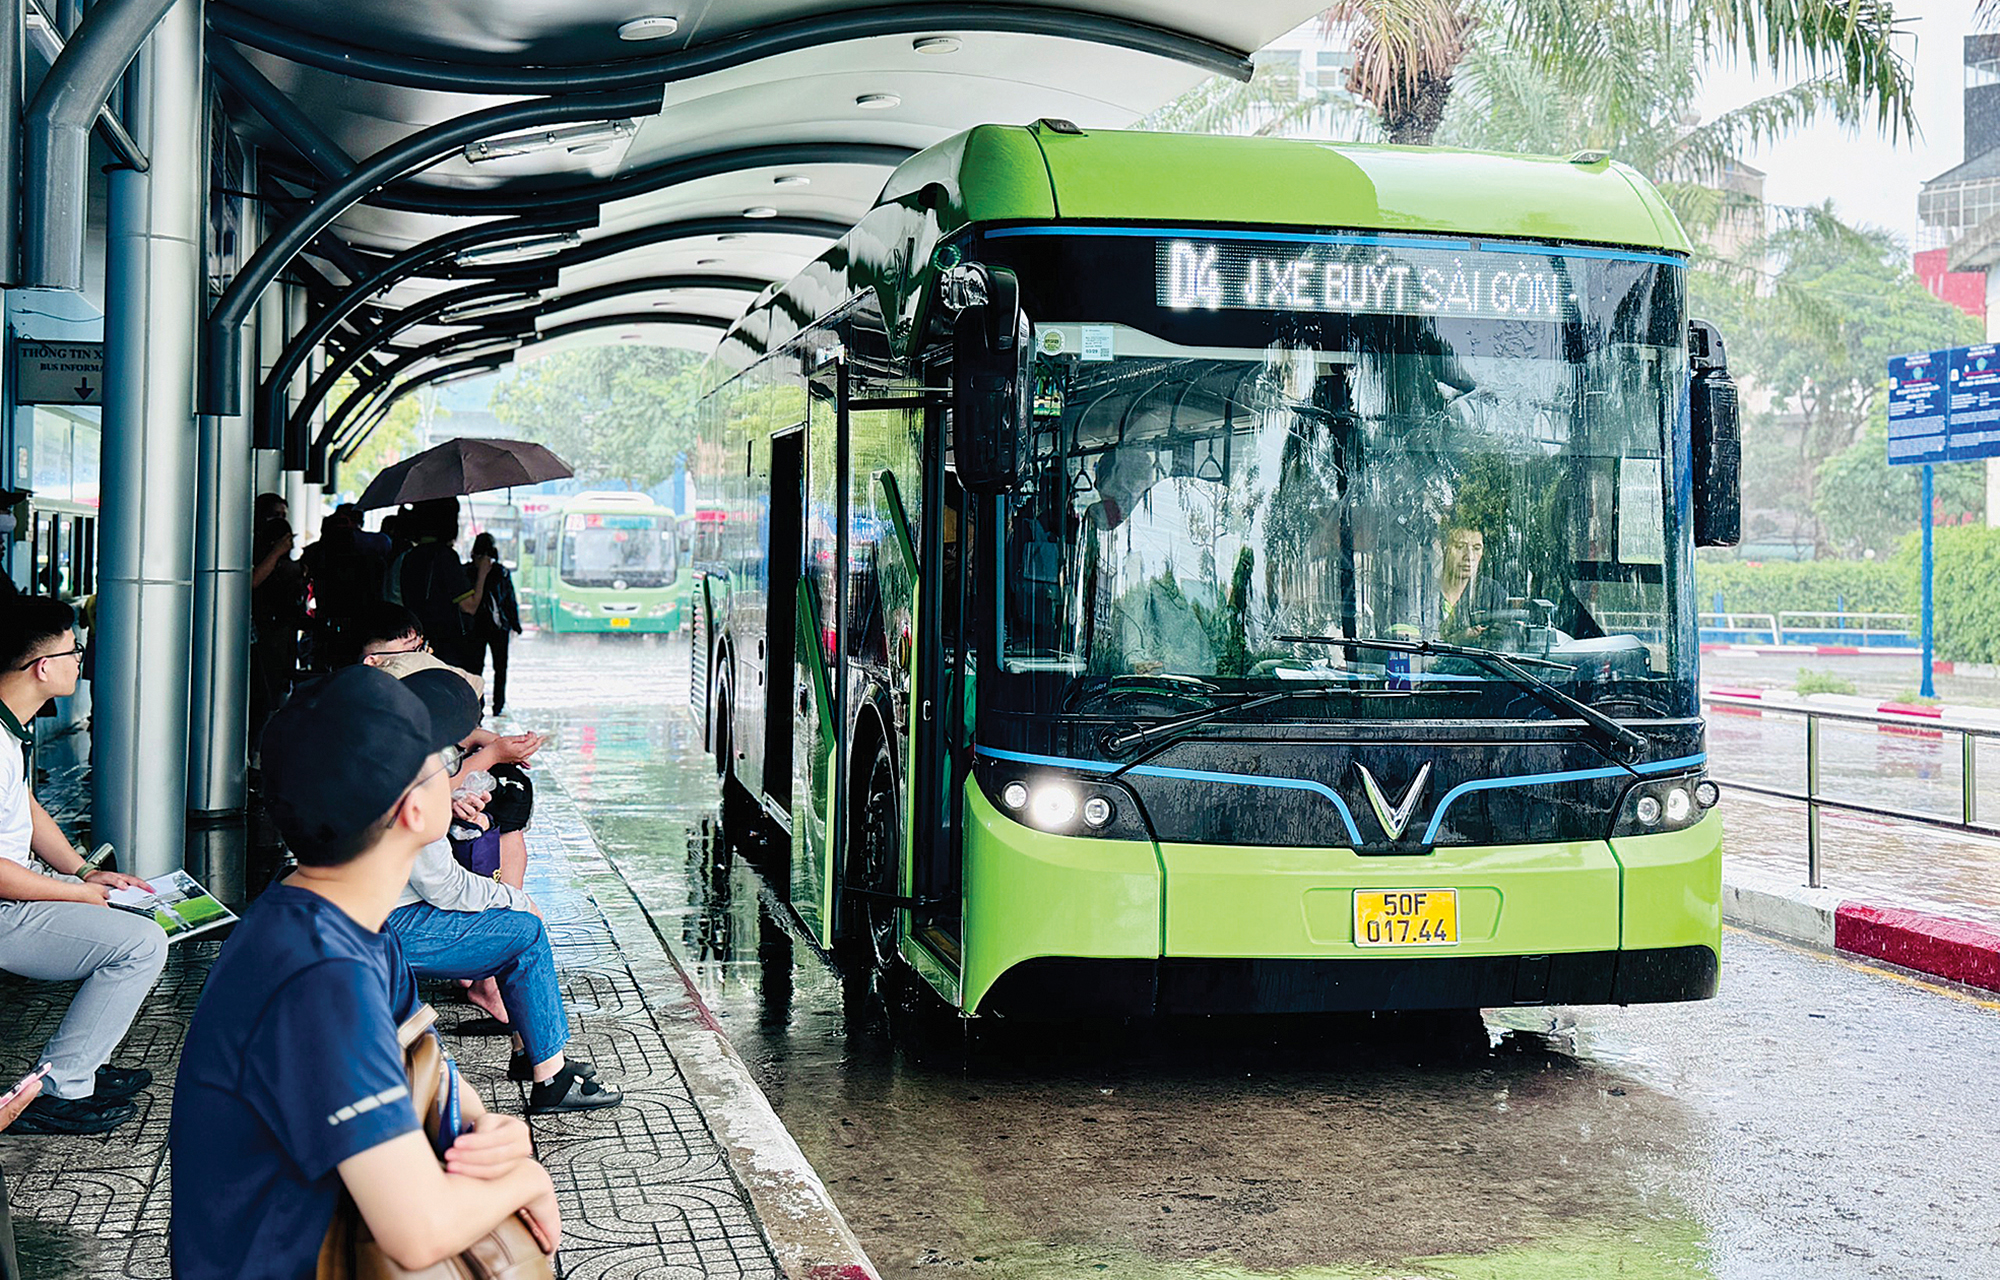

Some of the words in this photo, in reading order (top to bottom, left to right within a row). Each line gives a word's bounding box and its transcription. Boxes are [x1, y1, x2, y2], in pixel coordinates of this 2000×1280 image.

[1170, 240, 1220, 309] D4
[1268, 259, 1314, 305] XE
[1420, 256, 1480, 312] SÀI
[69, 348, 91, 359] TIN
[40, 362, 59, 371] BUS
[1383, 893, 1427, 916] 50F
[1367, 918, 1447, 943] 017.44
